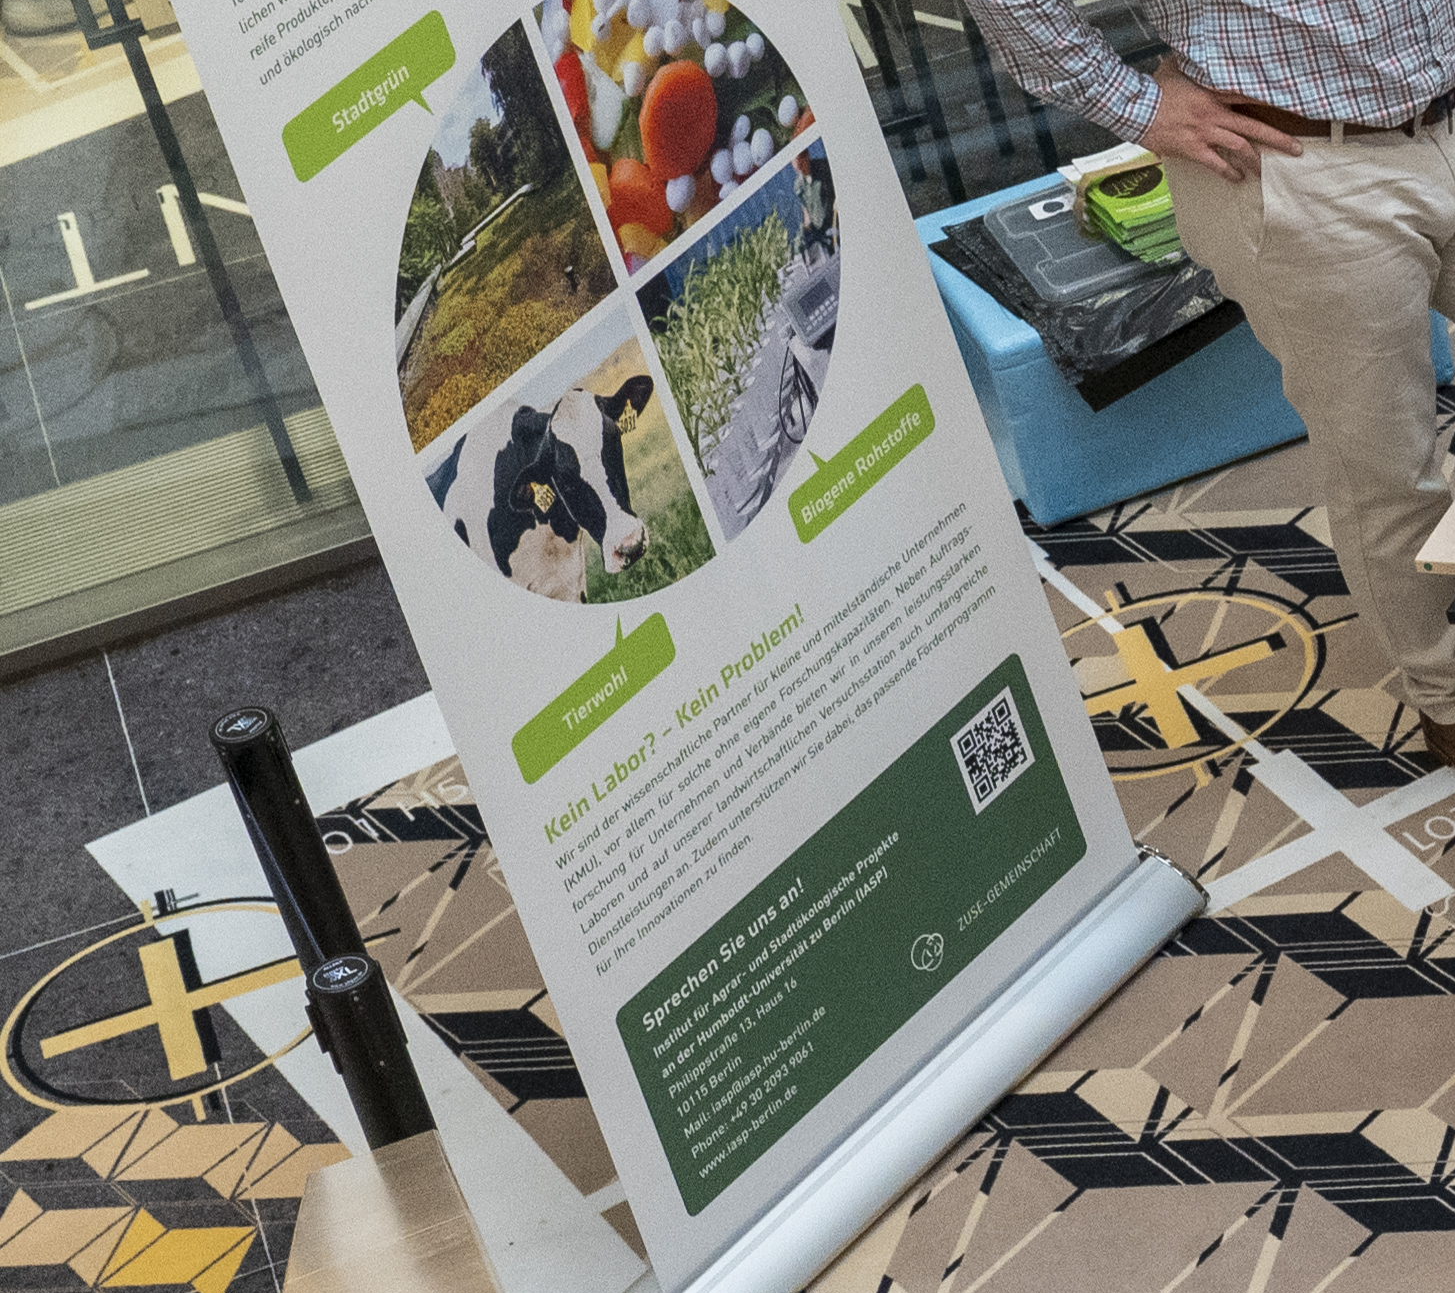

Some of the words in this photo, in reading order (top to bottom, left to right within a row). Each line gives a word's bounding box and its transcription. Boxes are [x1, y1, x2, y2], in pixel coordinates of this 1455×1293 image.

[330, 64, 410, 134] Stadtgrün
[799, 469, 856, 525] Biogene
[853, 410, 921, 477] Rohstoffe
[542, 796, 591, 845] Kein
[590, 730, 656, 803] Labor?
[673, 682, 720, 729] Kein
[719, 601, 805, 690] Problem!
[560, 664, 628, 730] Tierwohl
[956, 825, 1061, 932] ZUSE-GEMEINSCHAFT
[641, 957, 719, 1032] Sprechen
[718, 933, 746, 963] Sie
[746, 904, 777, 938] uns
[777, 875, 804, 911] an!
[651, 1016, 693, 1059] Institut
[692, 1000, 710, 1022] für
[711, 970, 747, 1007] Agrar-
[747, 946, 770, 973] und
[767, 870, 856, 954] Stadtökologische
[854, 830, 899, 875] Projekte
[661, 1060, 676, 1079] an
[675, 1041, 695, 1065] der
[695, 938, 809, 1047] Humboldt-Universität
[808, 927, 823, 945] zu
[821, 897, 856, 932] Berlin
[854, 864, 888, 903] (IASP)
[667, 1030, 738, 1099] Philippstraße
[738, 1015, 757, 1034] 13,
[754, 990, 784, 1020] Haus
[782, 975, 798, 993] 16
[675, 1082, 709, 1118] 10115
[707, 1054, 743, 1090] Berlin
[682, 1110, 711, 1140] Mail:
[709, 1005, 826, 1114] iasp@iasp.hu-berlin.de
[689, 1121, 727, 1159] Phone:
[729, 1099, 748, 1123] +49
[747, 1086, 763, 1107] 30
[762, 1062, 789, 1094] 2093
[787, 1039, 814, 1068] 9061
[697, 1083, 798, 1179] www.iasp-berlin.de
